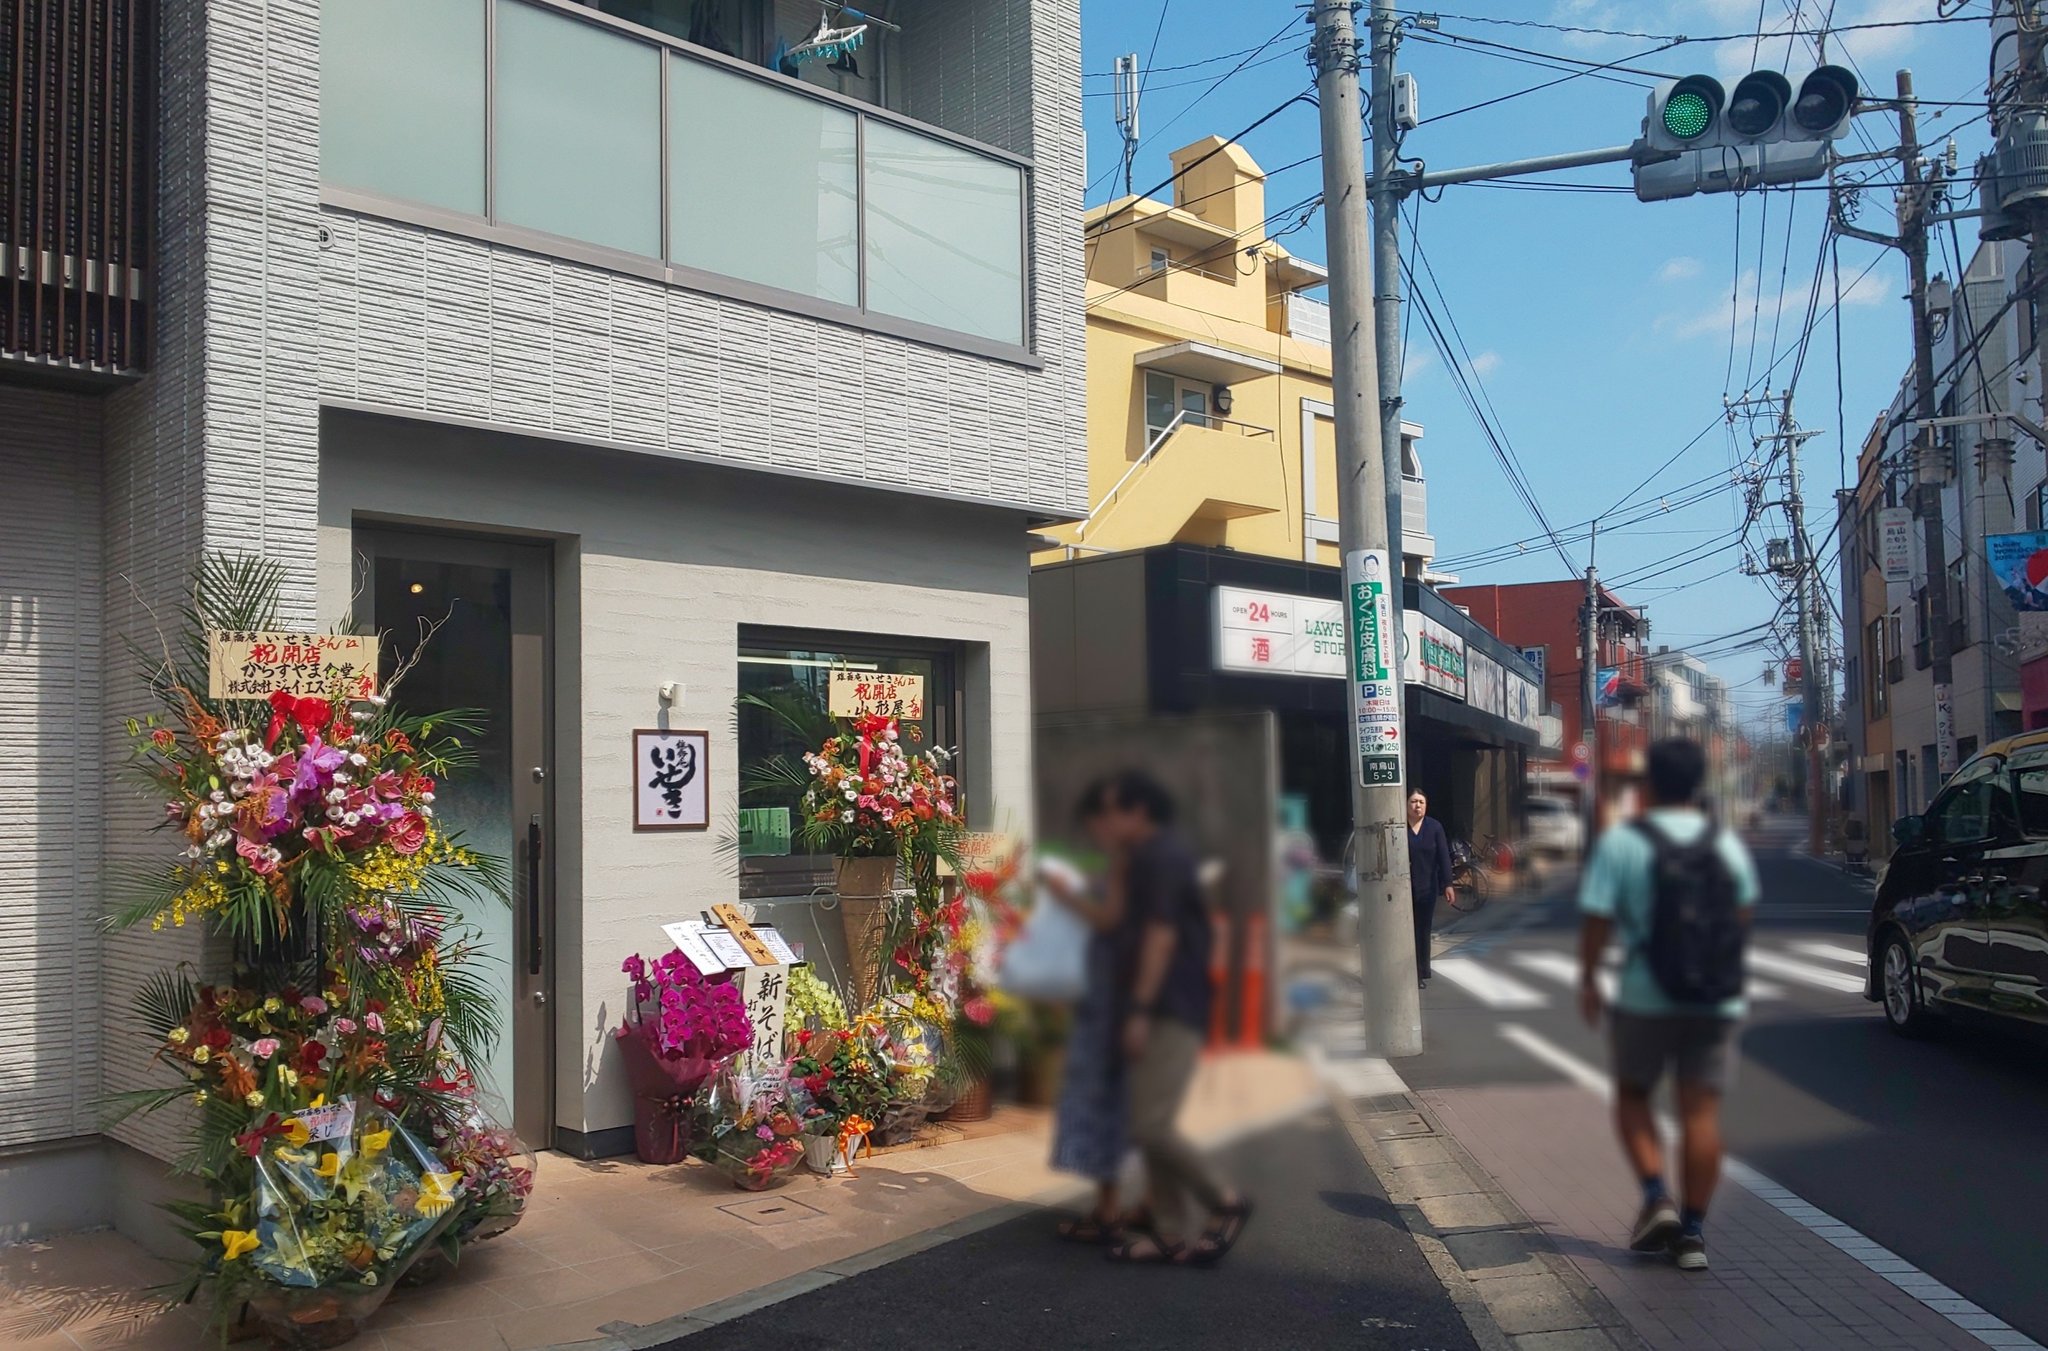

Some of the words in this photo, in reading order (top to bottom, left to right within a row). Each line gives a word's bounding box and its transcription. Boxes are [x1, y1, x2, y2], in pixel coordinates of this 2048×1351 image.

[1232, 606, 1248, 614] OPEN
[1248, 602, 1269, 622] 24
[1271, 611, 1288, 619] HOURS
[1357, 584, 1378, 679] おくだ皮膚科
[244, 644, 321, 664] 祝開店
[1252, 637, 1270, 662] 酒
[851, 683, 897, 700] 祝開店
[1378, 685, 1392, 696] 5台
[855, 700, 905, 716] 山形屋
[1373, 772, 1393, 780] 5-3
[757, 972, 782, 1061] 新そば
